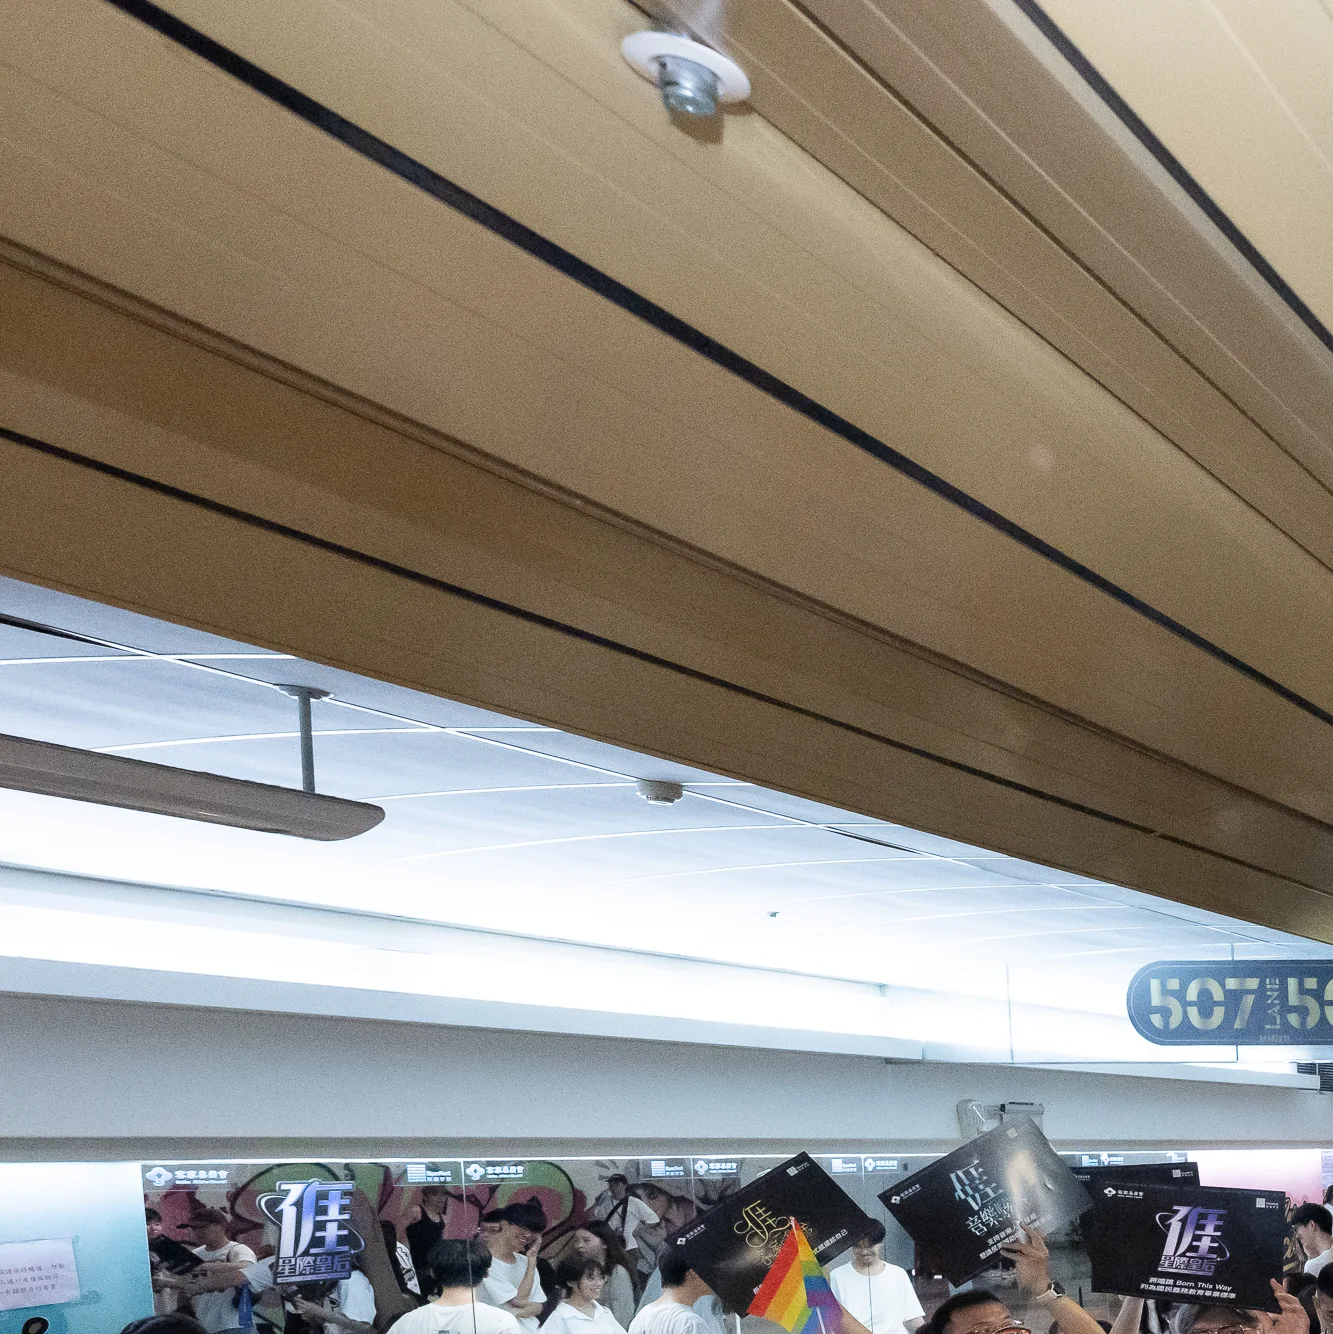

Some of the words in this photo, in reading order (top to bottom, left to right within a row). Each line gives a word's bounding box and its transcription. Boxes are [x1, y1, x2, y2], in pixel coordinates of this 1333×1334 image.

[1150, 977, 1260, 1030] 507
[1265, 978, 1281, 1030] LANE
[277, 1255, 351, 1276] 星際皇后
[1176, 1279, 1195, 1288] Born
[1198, 1281, 1215, 1290] This
[1216, 1283, 1232, 1291] Way
